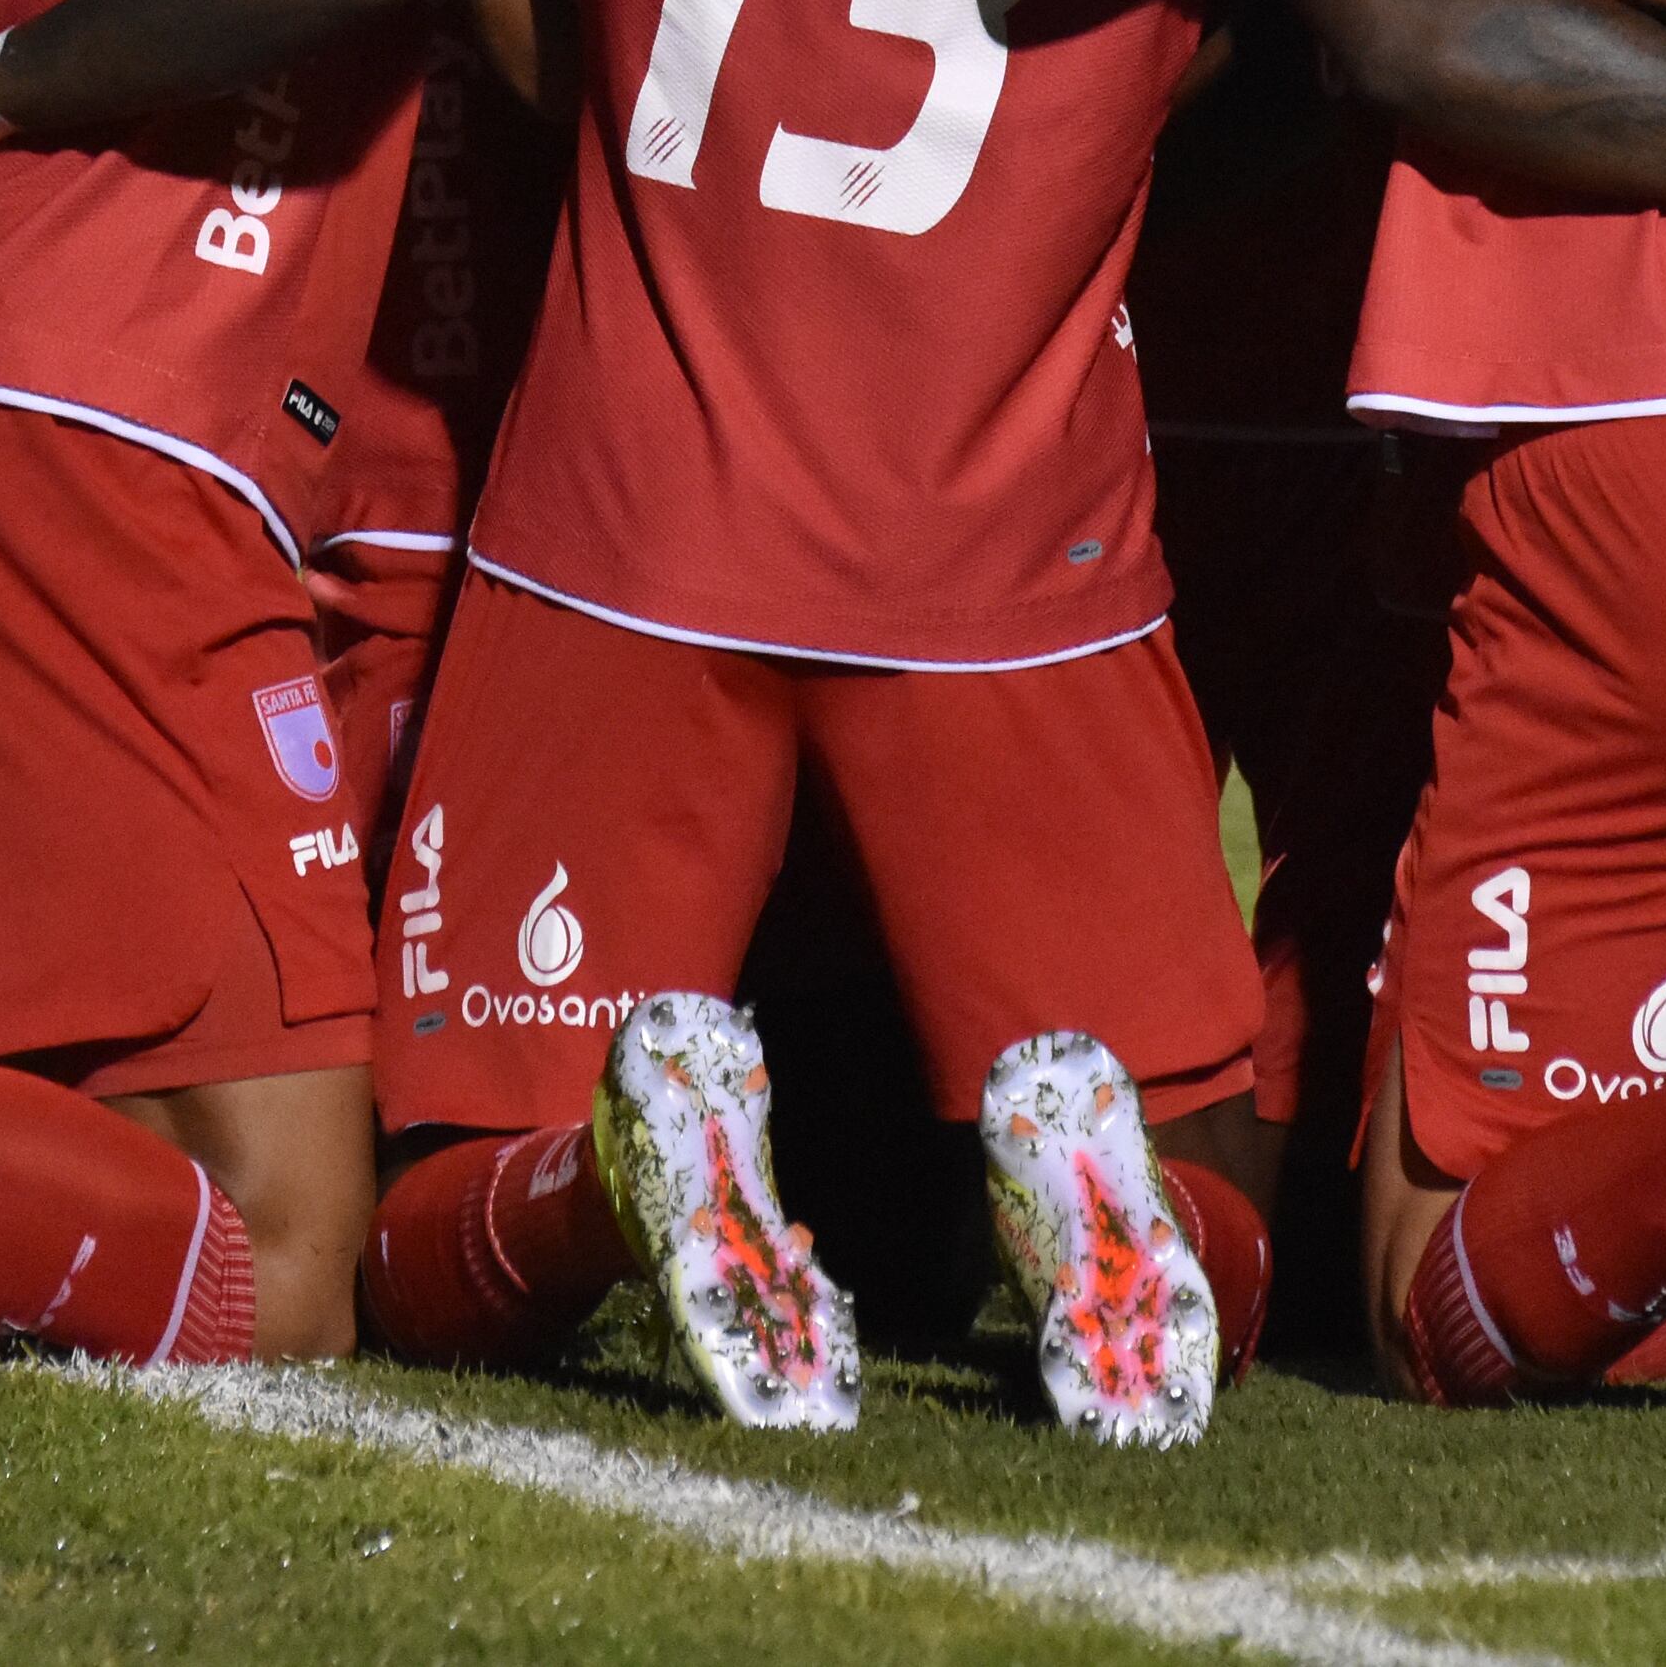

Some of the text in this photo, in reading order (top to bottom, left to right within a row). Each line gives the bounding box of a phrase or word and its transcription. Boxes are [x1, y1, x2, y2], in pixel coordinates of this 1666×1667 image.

[288, 389, 314, 420] FILA
[261, 687, 304, 714] SANTA
[289, 822, 359, 877] FILA
[400, 803, 450, 999] FILA
[1467, 866, 1531, 1052] FILA
[461, 985, 646, 1028] Ovosant
